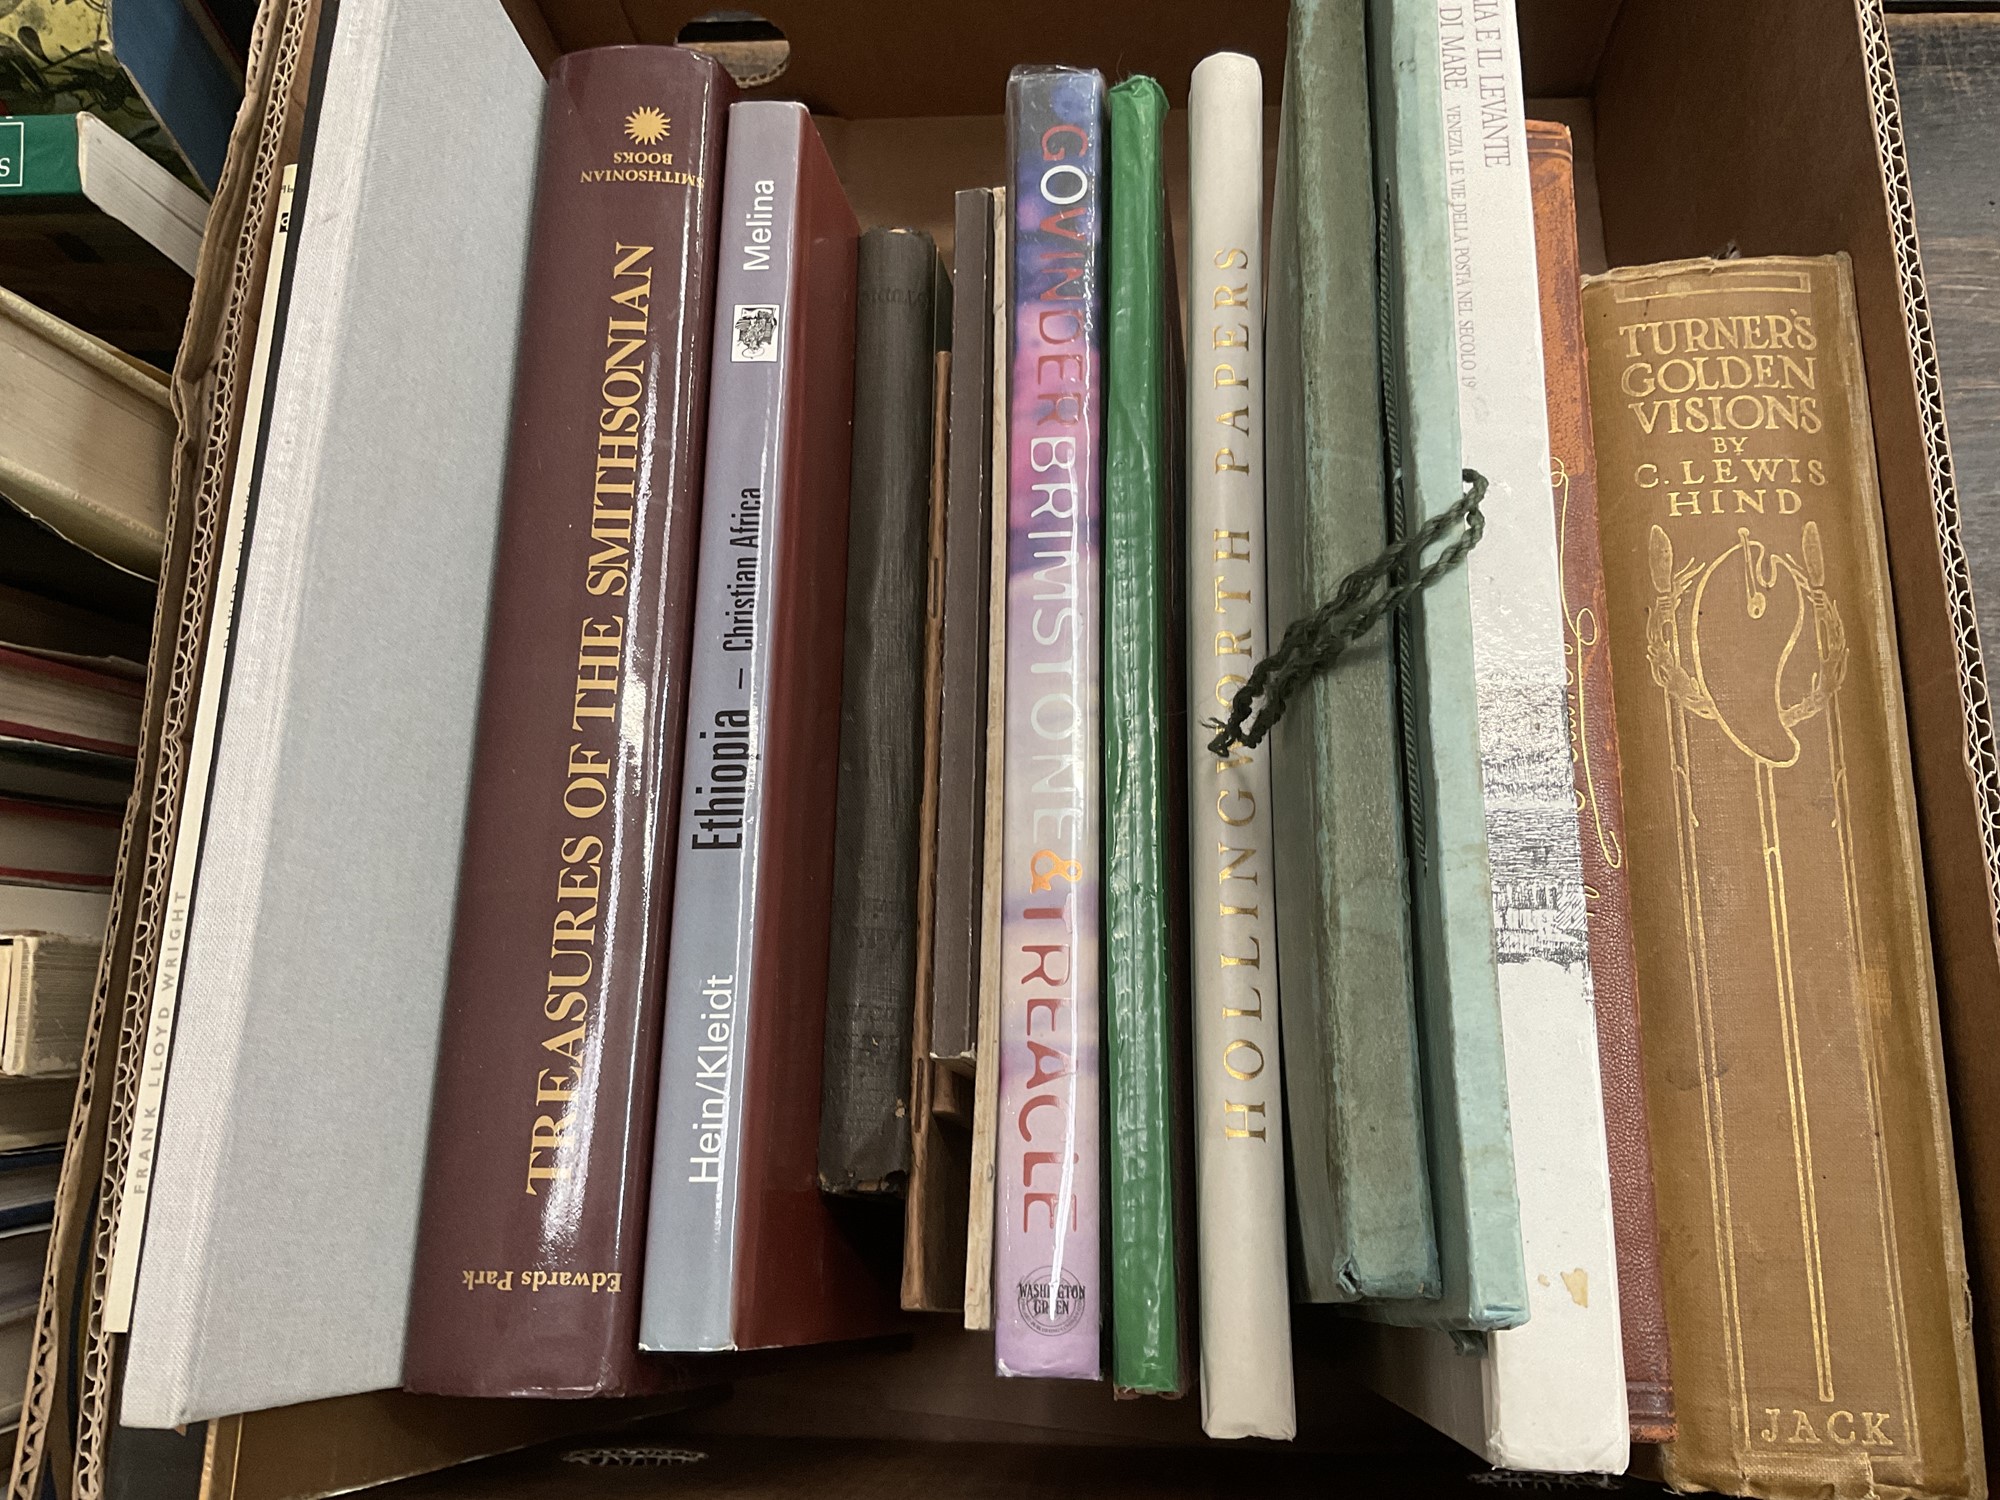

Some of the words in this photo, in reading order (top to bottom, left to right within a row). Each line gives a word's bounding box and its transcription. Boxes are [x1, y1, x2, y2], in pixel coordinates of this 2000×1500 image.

[1439, 7, 1463, 28] DI
[1476, 28, 1501, 42] E
[1441, 35, 1468, 90] MARE
[1477, 48, 1503, 68] IL
[1446, 105, 1463, 156] VENEZIA
[1479, 75, 1511, 168] LEVANTE
[580, 169, 705, 188] SMITHSONIAN
[613, 152, 673, 165] BOOKS
[1449, 160, 1465, 176] LE
[1451, 179, 1466, 200] VIE
[742, 180, 775, 270] Melina
[1452, 203, 1469, 243] DELLA
[1037, 124, 1089, 426] GOVINDER
[1454, 247, 1471, 286] POSTA
[1456, 290, 1473, 316] NEL
[1459, 320, 1477, 371] SECOLO
[1618, 308, 1818, 359] TURNER'S
[1213, 247, 1250, 476] PAPERS
[1620, 354, 1817, 398] GOLDEN
[585, 241, 655, 597] SMITHSONIAN
[1628, 394, 1823, 435] VISIONS
[1711, 436, 1749, 455] BY
[1634, 463, 1670, 488] C.
[1680, 457, 1827, 486] LEWIS
[729, 487, 761, 548] Africa
[1666, 488, 1802, 517] HIND
[722, 555, 758, 651] Christian
[1028, 436, 1084, 842] BRIMSTONE
[571, 615, 624, 733] THE
[563, 742, 611, 818] OF
[691, 708, 761, 850] Ethiopia
[1030, 850, 1083, 894] &
[525, 834, 604, 1196] TREASURES
[134, 1107, 157, 1195] FRANK
[149, 1006, 170, 1087] LLOYD
[162, 891, 187, 991] WRIGHT
[1018, 893, 1080, 1234] TREACLE
[688, 974, 734, 1182] Hein/Kleidt
[461, 1270, 515, 1291] Park
[521, 1270, 623, 1293] Edwards
[1016, 1281, 1086, 1300] WASHIGTON
[1033, 1299, 1070, 1316] GREN
[1760, 1407, 1894, 1446] JACK
